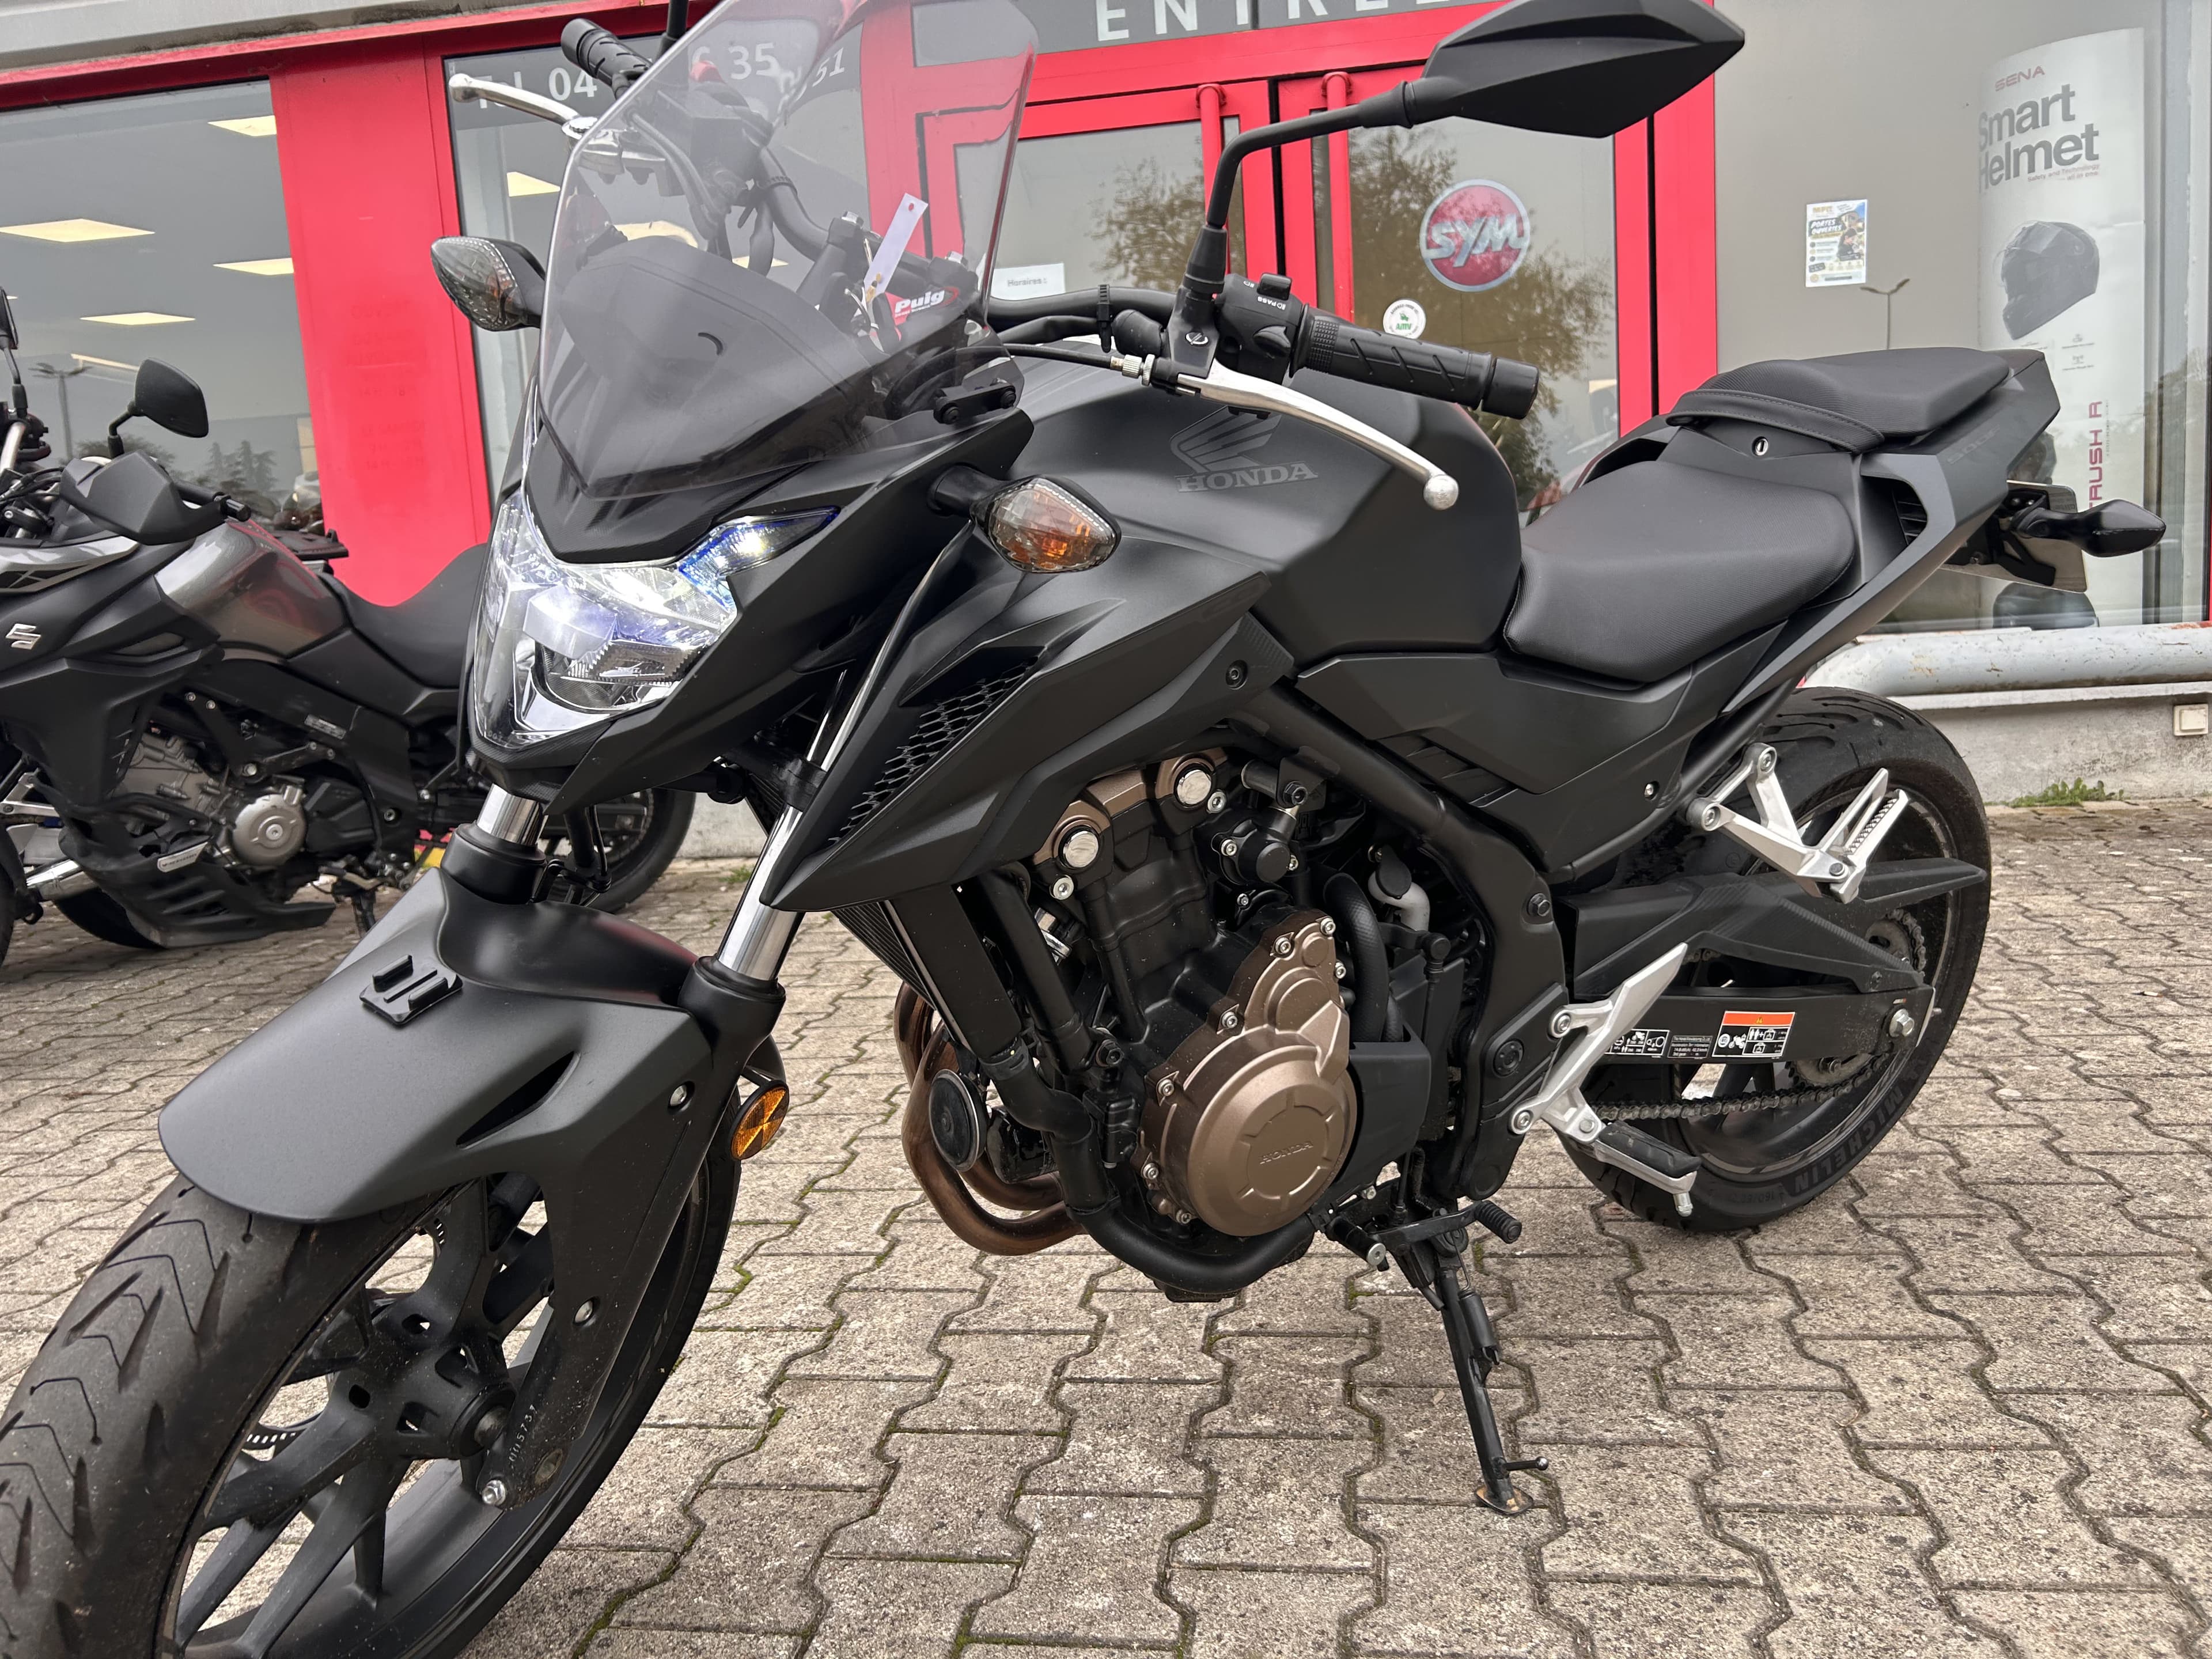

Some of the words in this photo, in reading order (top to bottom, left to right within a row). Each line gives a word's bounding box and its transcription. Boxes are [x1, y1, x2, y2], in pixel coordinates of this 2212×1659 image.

[548, 67, 597, 101] 04
[728, 42, 783, 79] 35
[812, 47, 845, 87] 51
[1995, 66, 2045, 92] SENA
[1979, 84, 2075, 152] Smart
[1978, 123, 2099, 193] Helmet
[1423, 213, 1525, 267] SYM
[895, 290, 945, 313] Puig
[1176, 462, 1318, 492] HONDA
[1259, 1141, 1314, 1165] HONDA
[1794, 1086, 1904, 1194] MICHELIN
